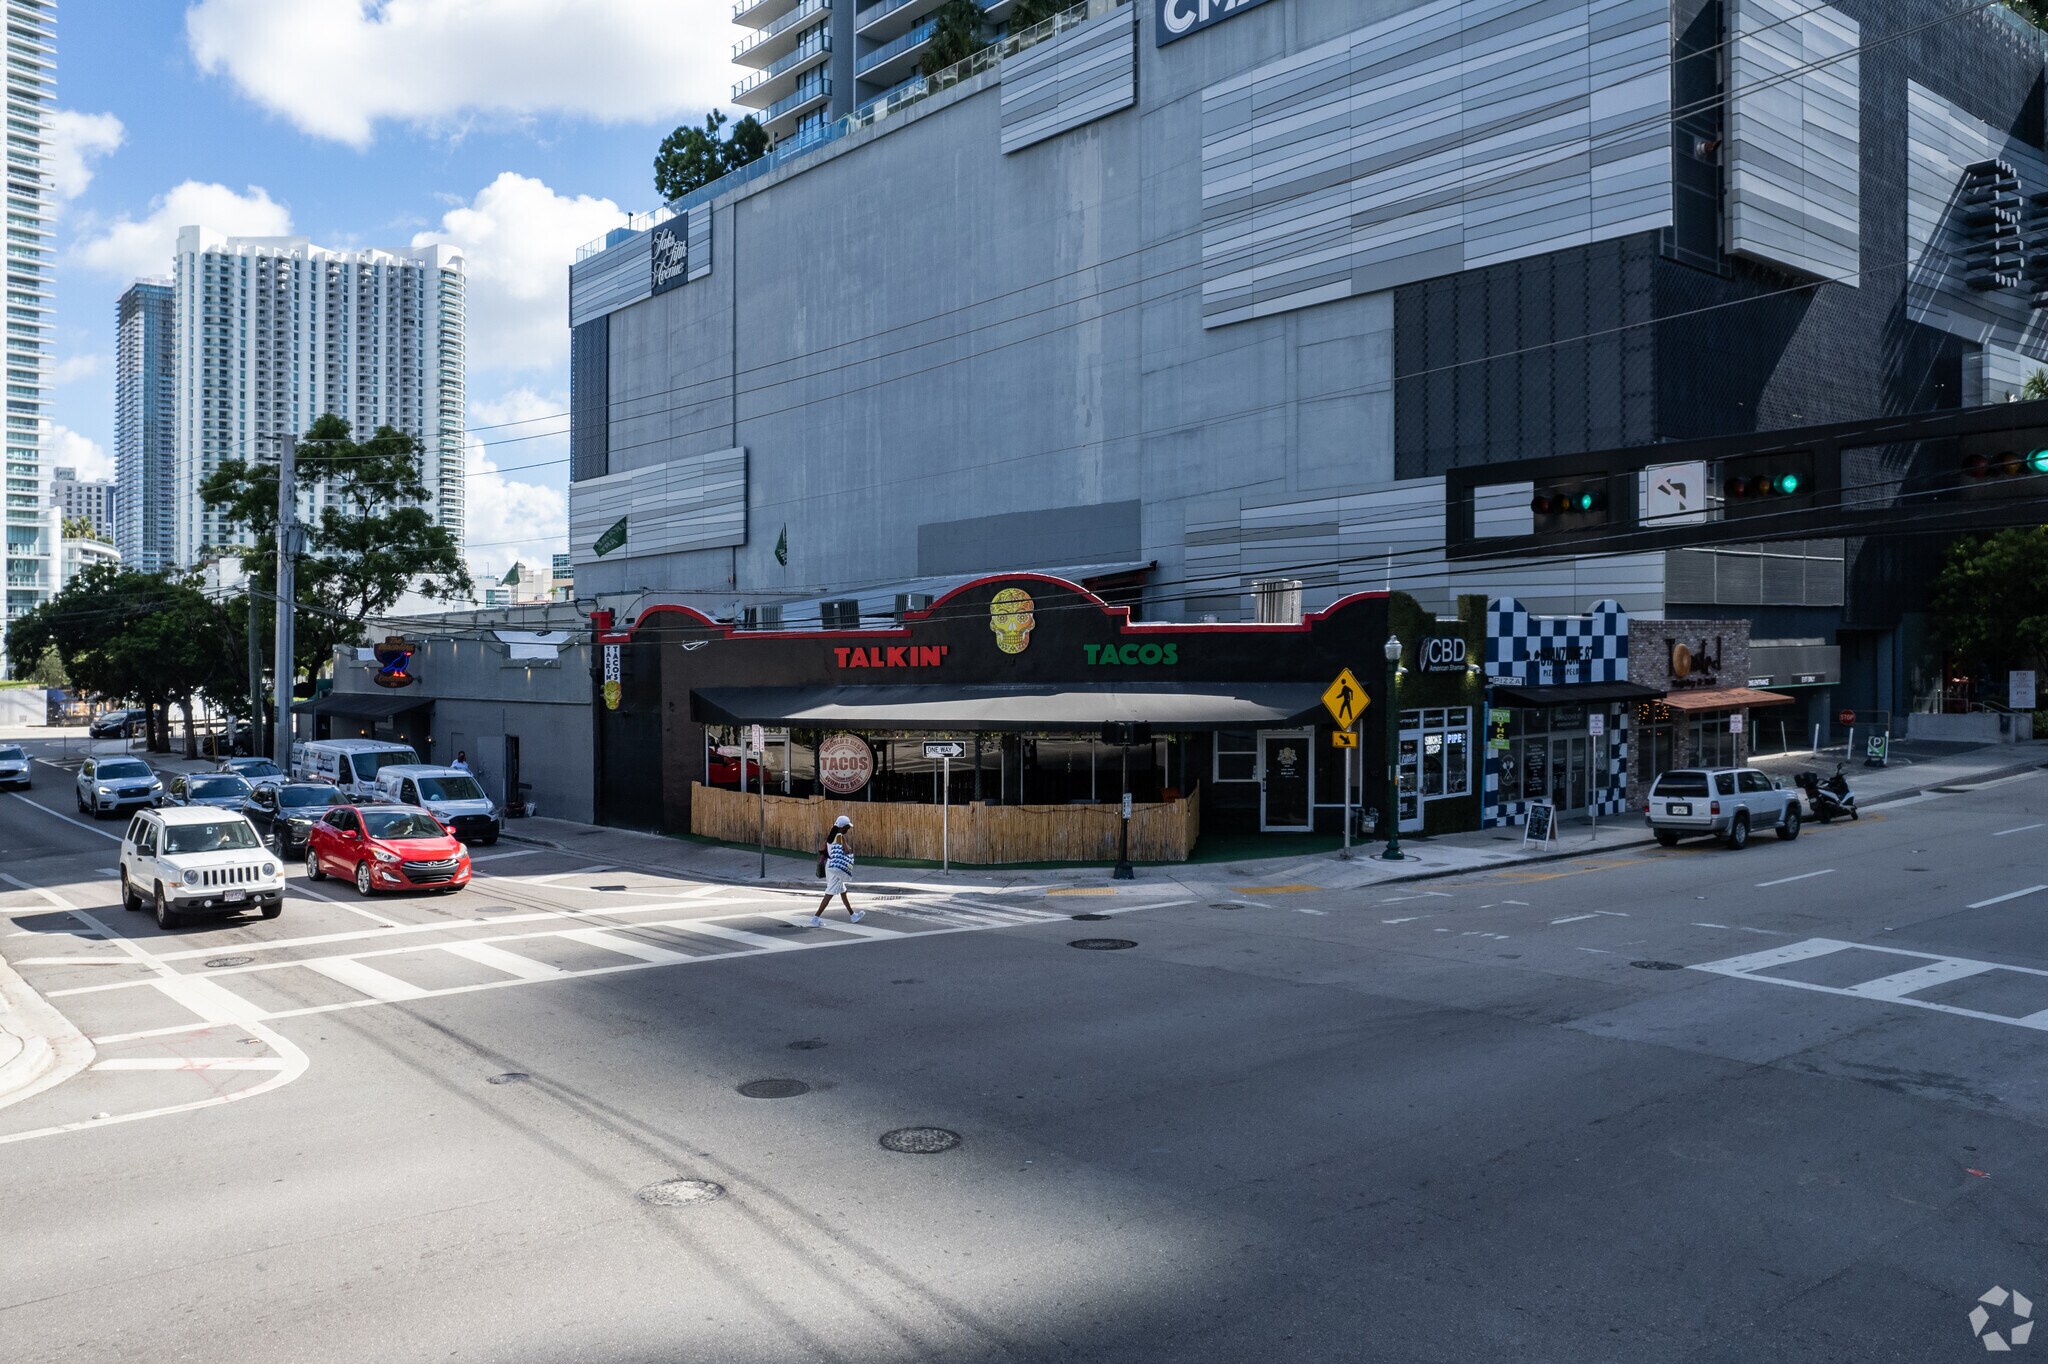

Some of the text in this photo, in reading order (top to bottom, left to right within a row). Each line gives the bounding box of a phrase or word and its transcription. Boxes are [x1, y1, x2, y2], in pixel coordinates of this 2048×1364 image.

[652, 228, 676, 260] Saks
[663, 240, 688, 268] Fifth
[652, 261, 685, 288] Avenue
[834, 645, 948, 668] TALKIN'
[1083, 643, 1179, 665] TACOS
[1429, 638, 1466, 663] CBD
[1494, 677, 1521, 685] PIZZA
[1424, 734, 1442, 746] SMOKE
[1873, 737, 1882, 747] P
[1426, 744, 1441, 755] SHOP
[821, 756, 868, 770] TACOS
[825, 775, 864, 789] WORLD'S BEST
